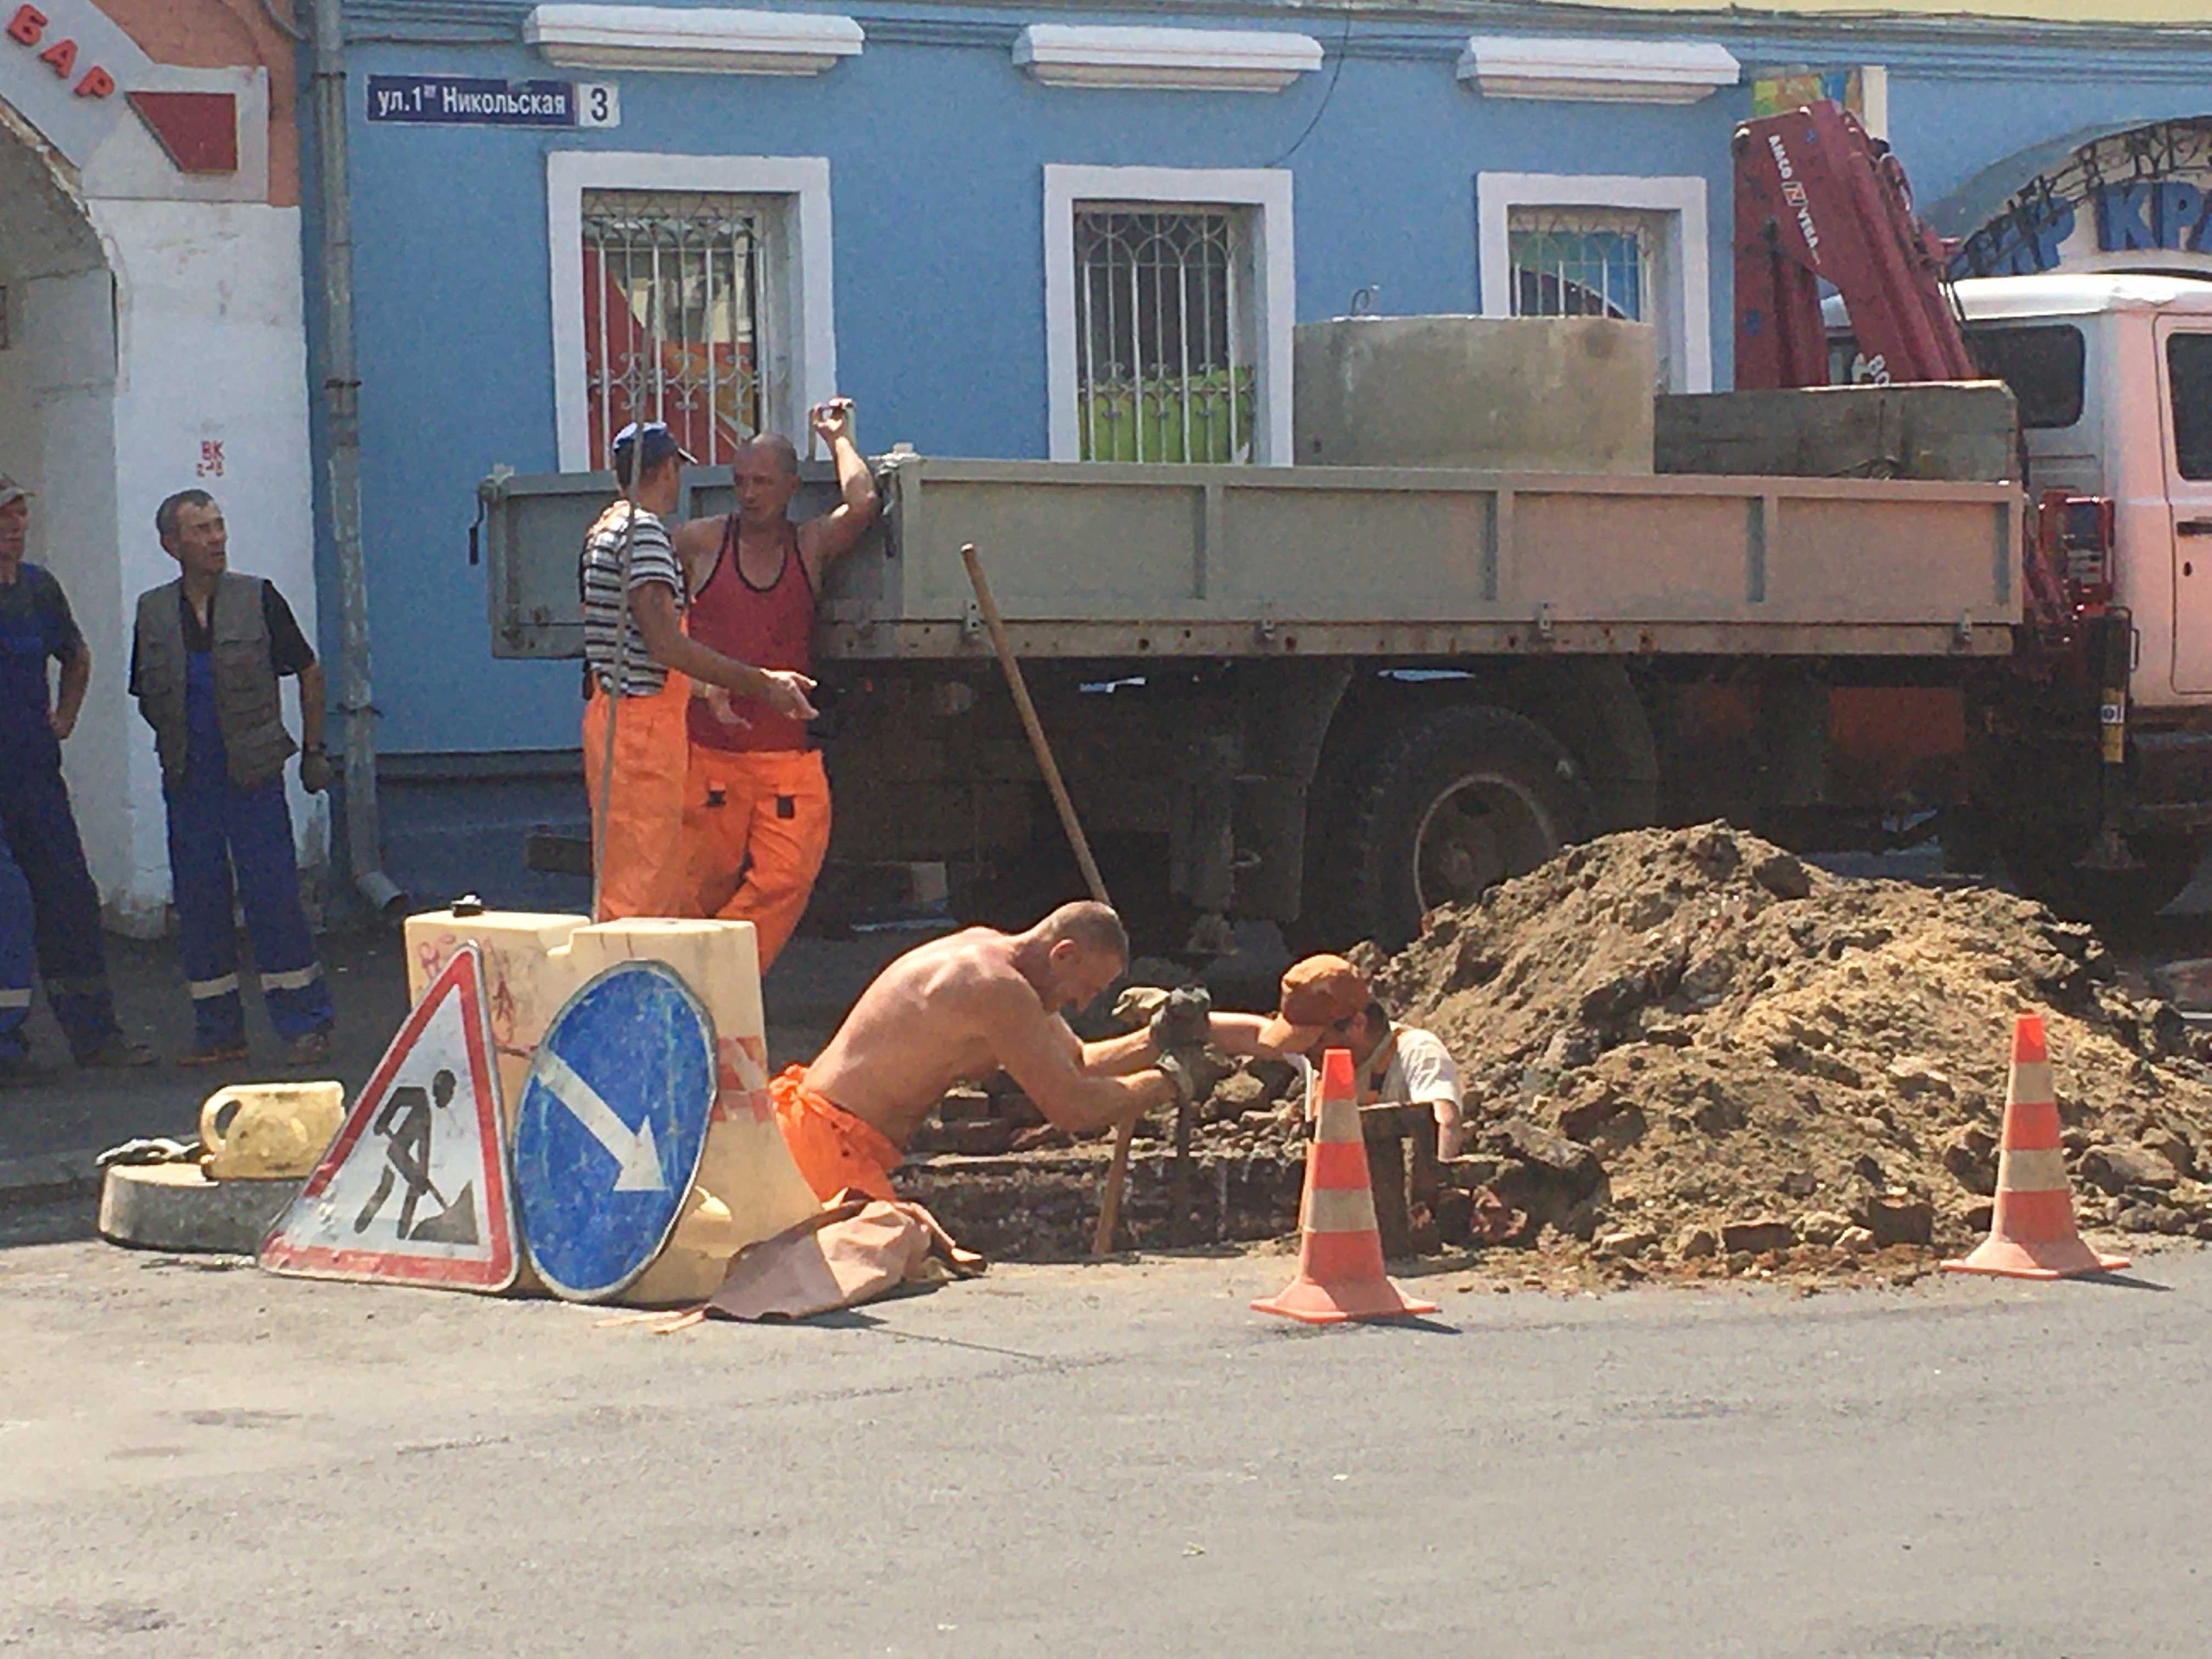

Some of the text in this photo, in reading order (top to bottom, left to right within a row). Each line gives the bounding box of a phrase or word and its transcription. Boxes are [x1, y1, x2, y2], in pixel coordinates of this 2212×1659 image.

[6, 3, 115, 99] БАР
[442, 86, 565, 114] Никольская
[591, 87, 608, 122] 3
[1769, 135, 1793, 179] AMCO
[2098, 181, 2212, 254] КР
